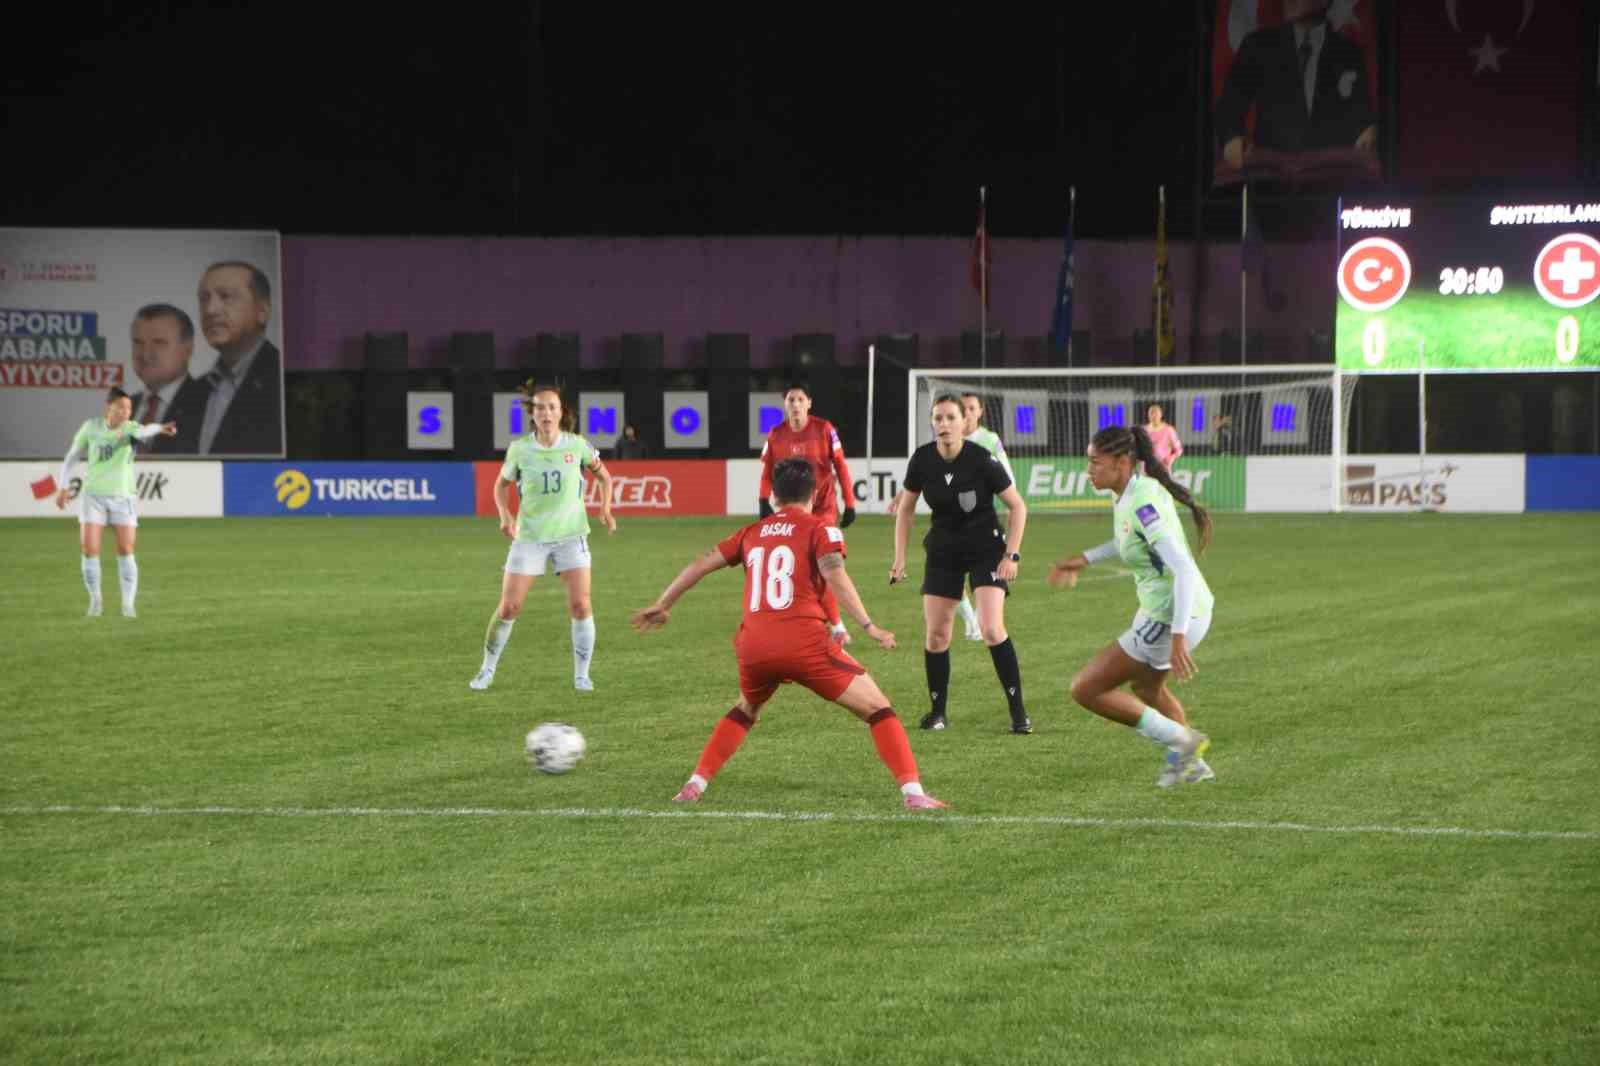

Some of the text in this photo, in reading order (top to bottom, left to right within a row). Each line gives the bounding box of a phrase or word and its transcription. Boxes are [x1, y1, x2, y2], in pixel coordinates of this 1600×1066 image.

[1363, 318, 1386, 365] 0
[1555, 316, 1579, 363] 0
[313, 478, 436, 501] TURKCELL
[541, 470, 561, 494] 13
[1379, 483, 1447, 505] PASS
[747, 545, 795, 613] 18
